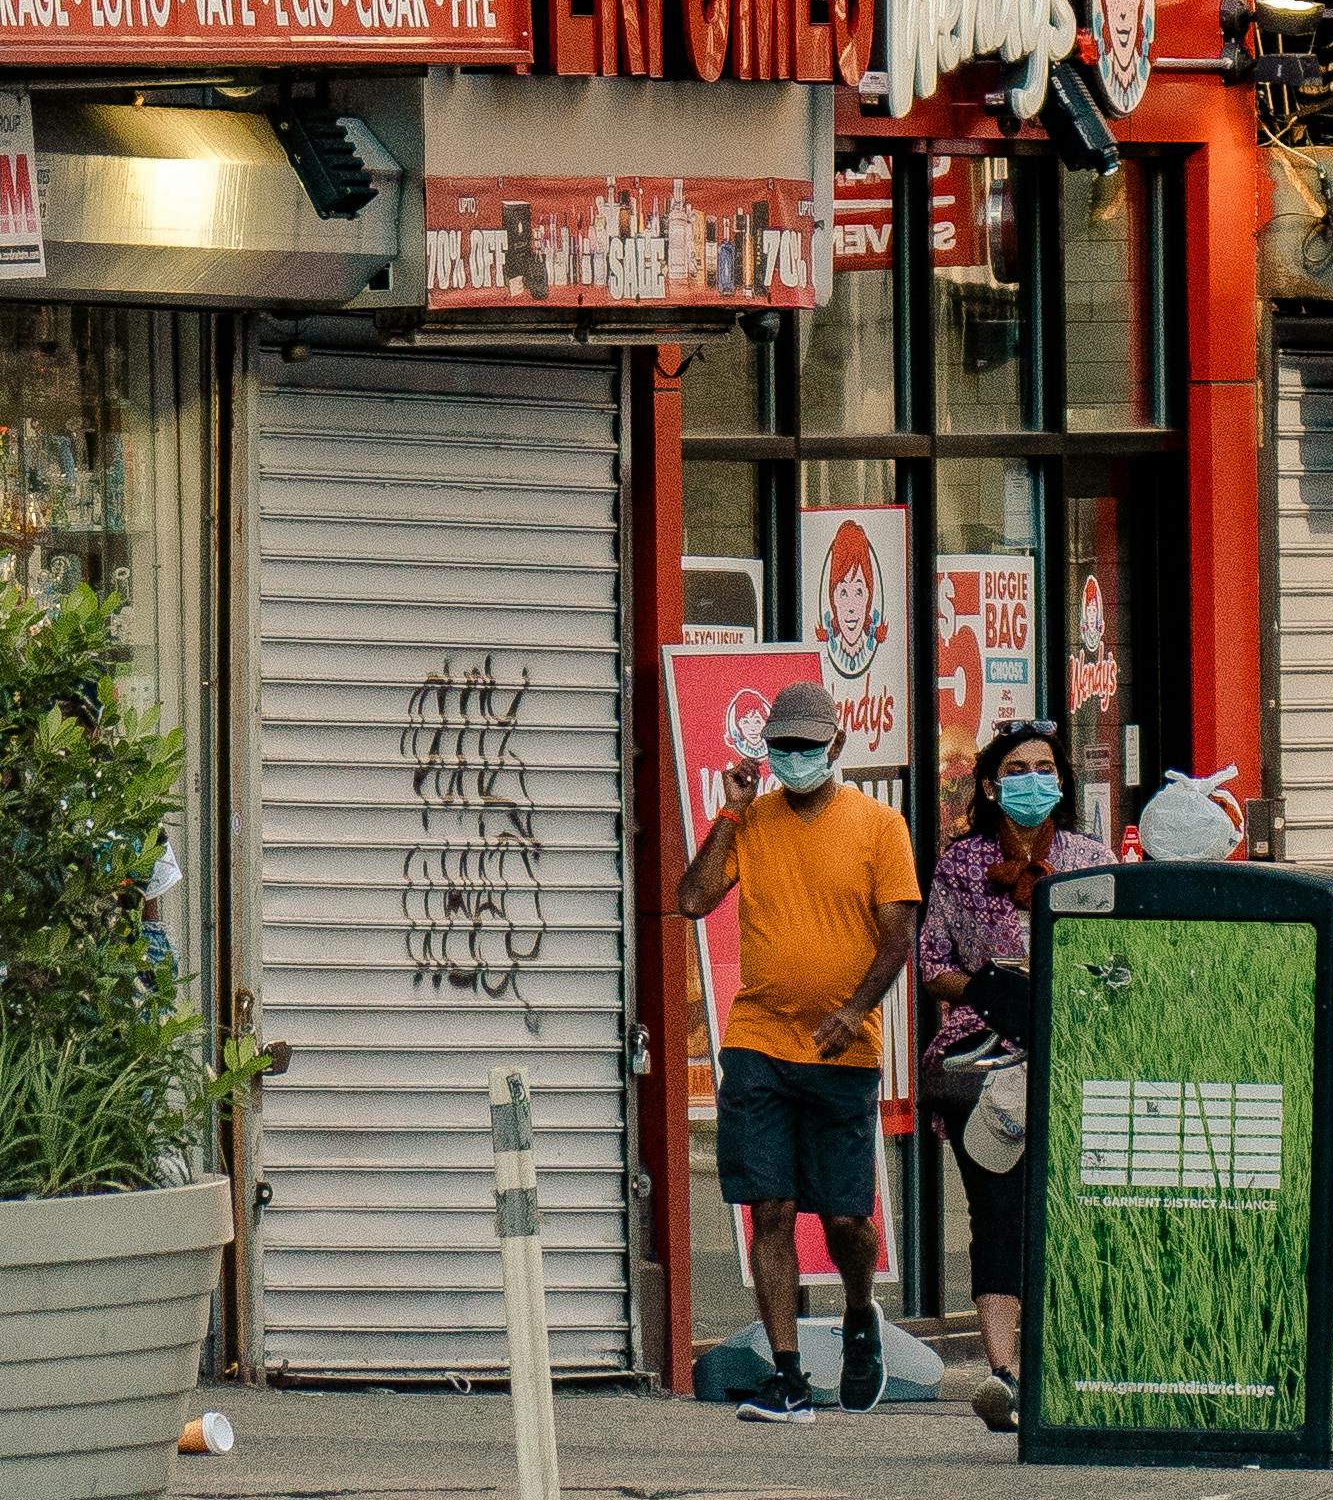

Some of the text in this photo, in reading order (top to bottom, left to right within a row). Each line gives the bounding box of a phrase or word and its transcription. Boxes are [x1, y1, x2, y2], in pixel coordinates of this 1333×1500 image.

[468, 228, 509, 288] OFF
[607, 238, 666, 301] SALE
[1076, 1195, 1278, 1213] THE GARMENT DISTRICT ALLIANCE
[1074, 1376, 1276, 1399] www.garmentdistrict.nyc
